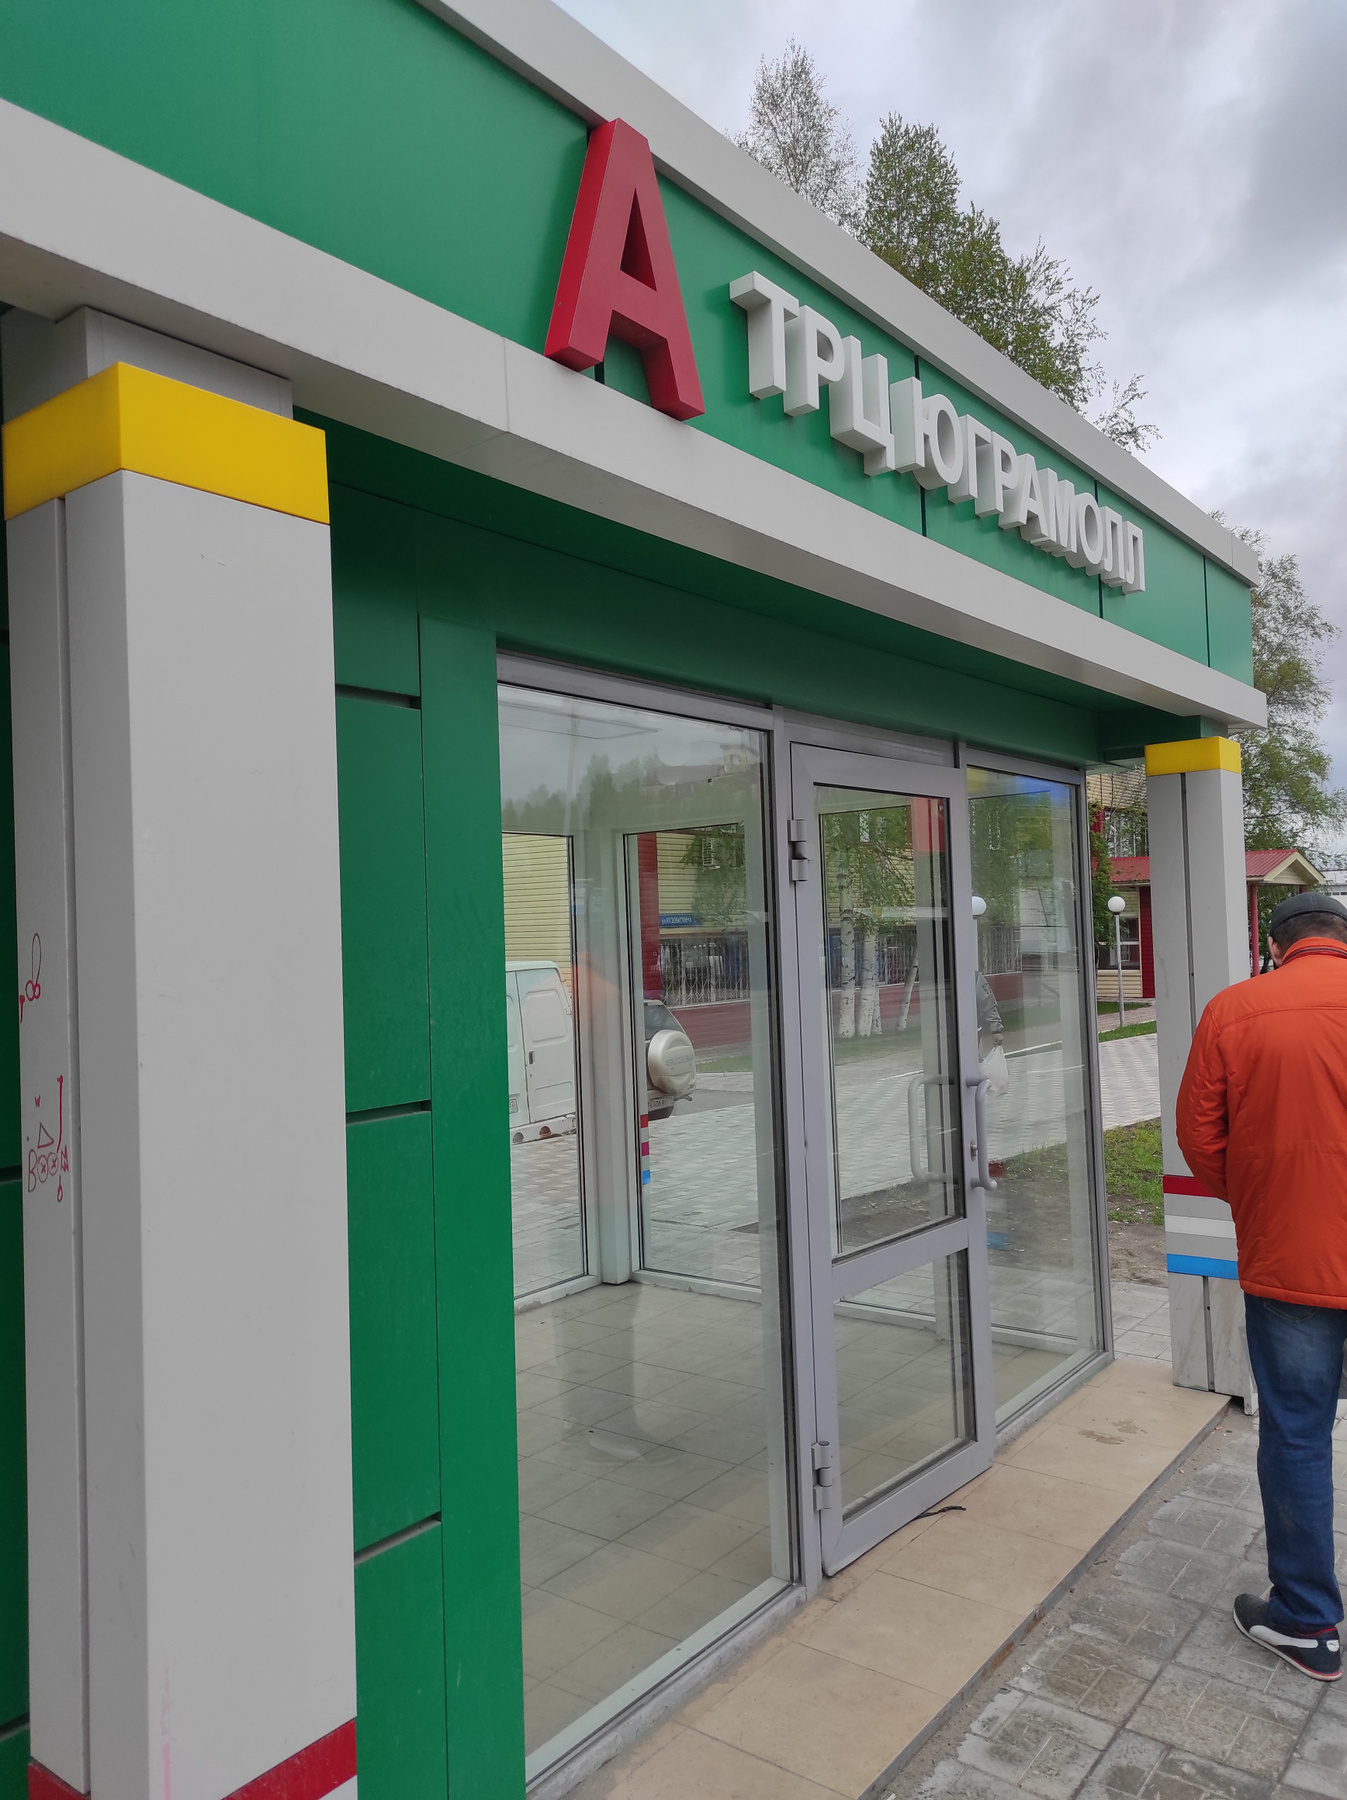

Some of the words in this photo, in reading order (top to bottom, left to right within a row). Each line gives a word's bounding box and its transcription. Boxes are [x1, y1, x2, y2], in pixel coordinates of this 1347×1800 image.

[544, 117, 706, 422] А
[729, 270, 896, 477] ТРЦ
[890, 376, 1146, 596] ЮГРАМОЛЛ
